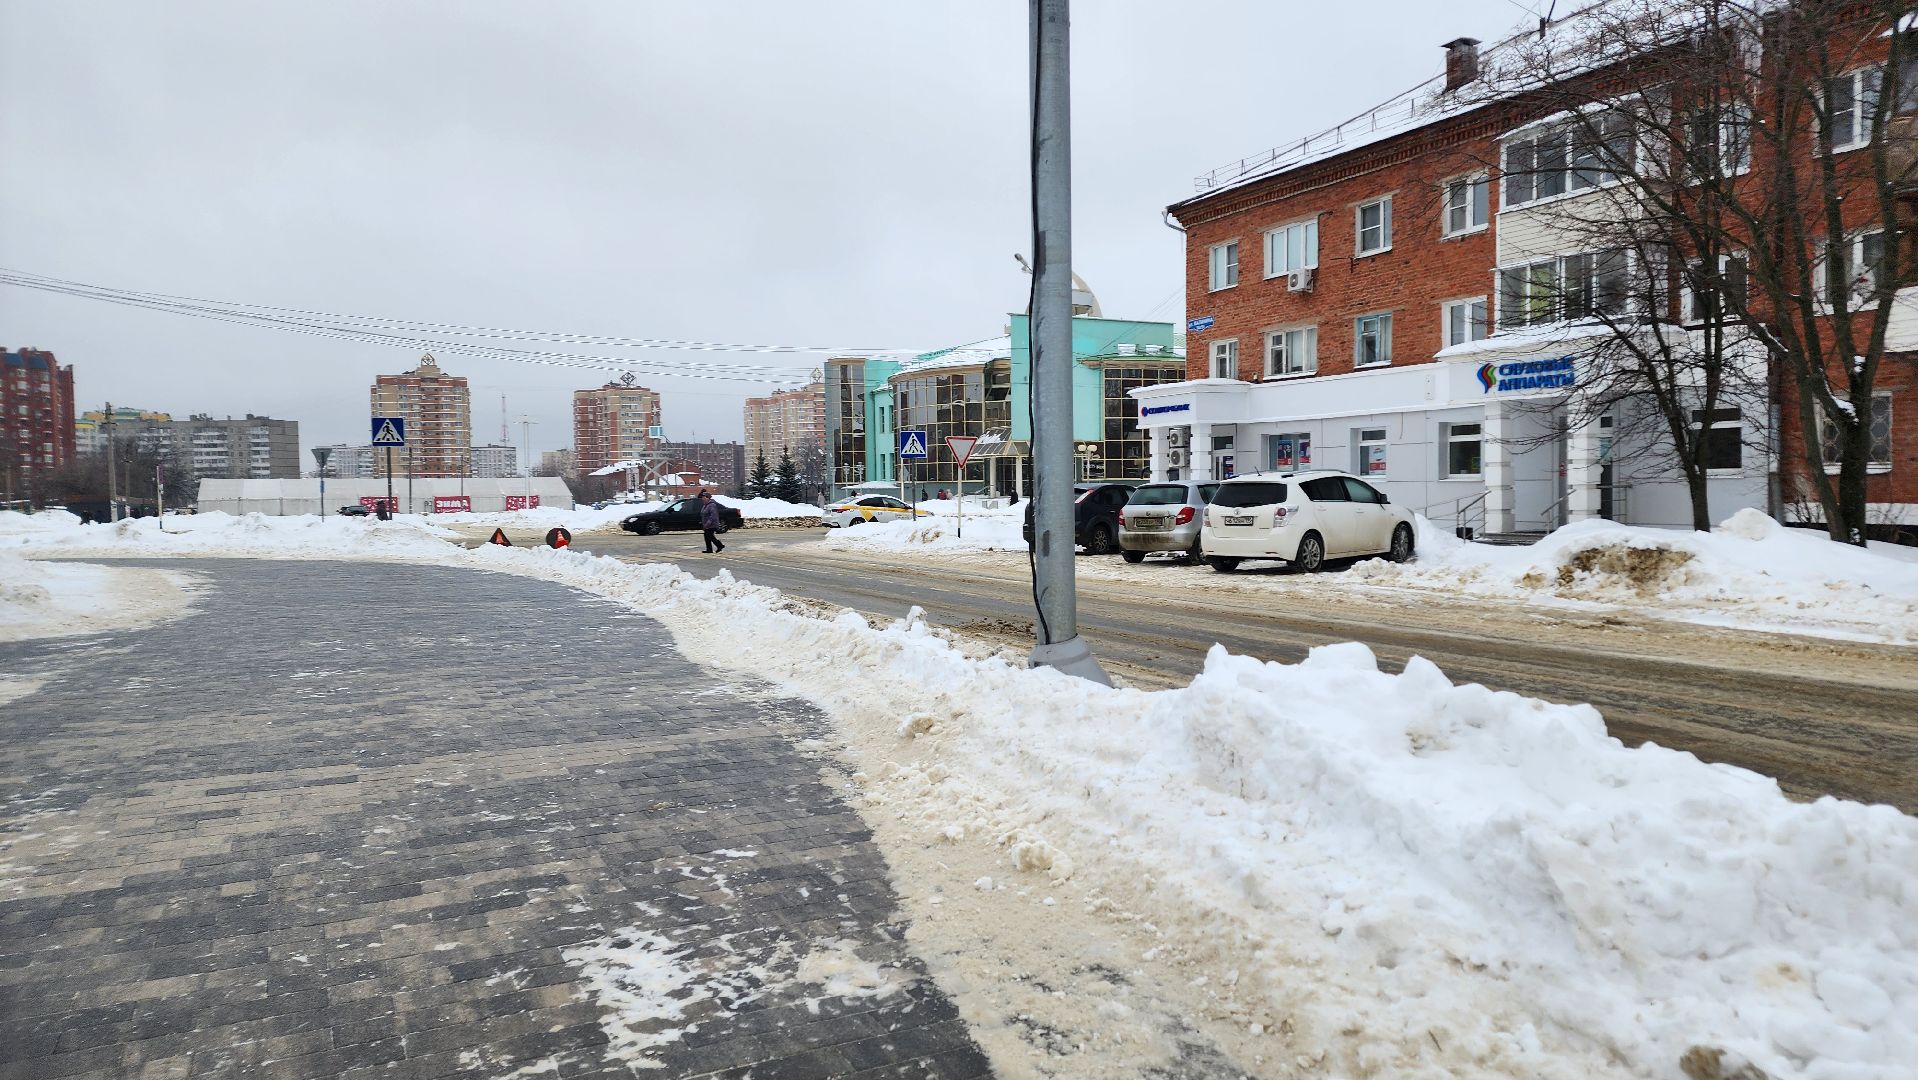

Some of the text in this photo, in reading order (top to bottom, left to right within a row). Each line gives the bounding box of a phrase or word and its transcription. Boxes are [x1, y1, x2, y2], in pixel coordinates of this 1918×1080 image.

[1499, 357, 1575, 376] СЛУХОВЫЕ
[1498, 372, 1575, 391] АППАРАТЫ
[436, 499, 469, 508] ЗИМА
